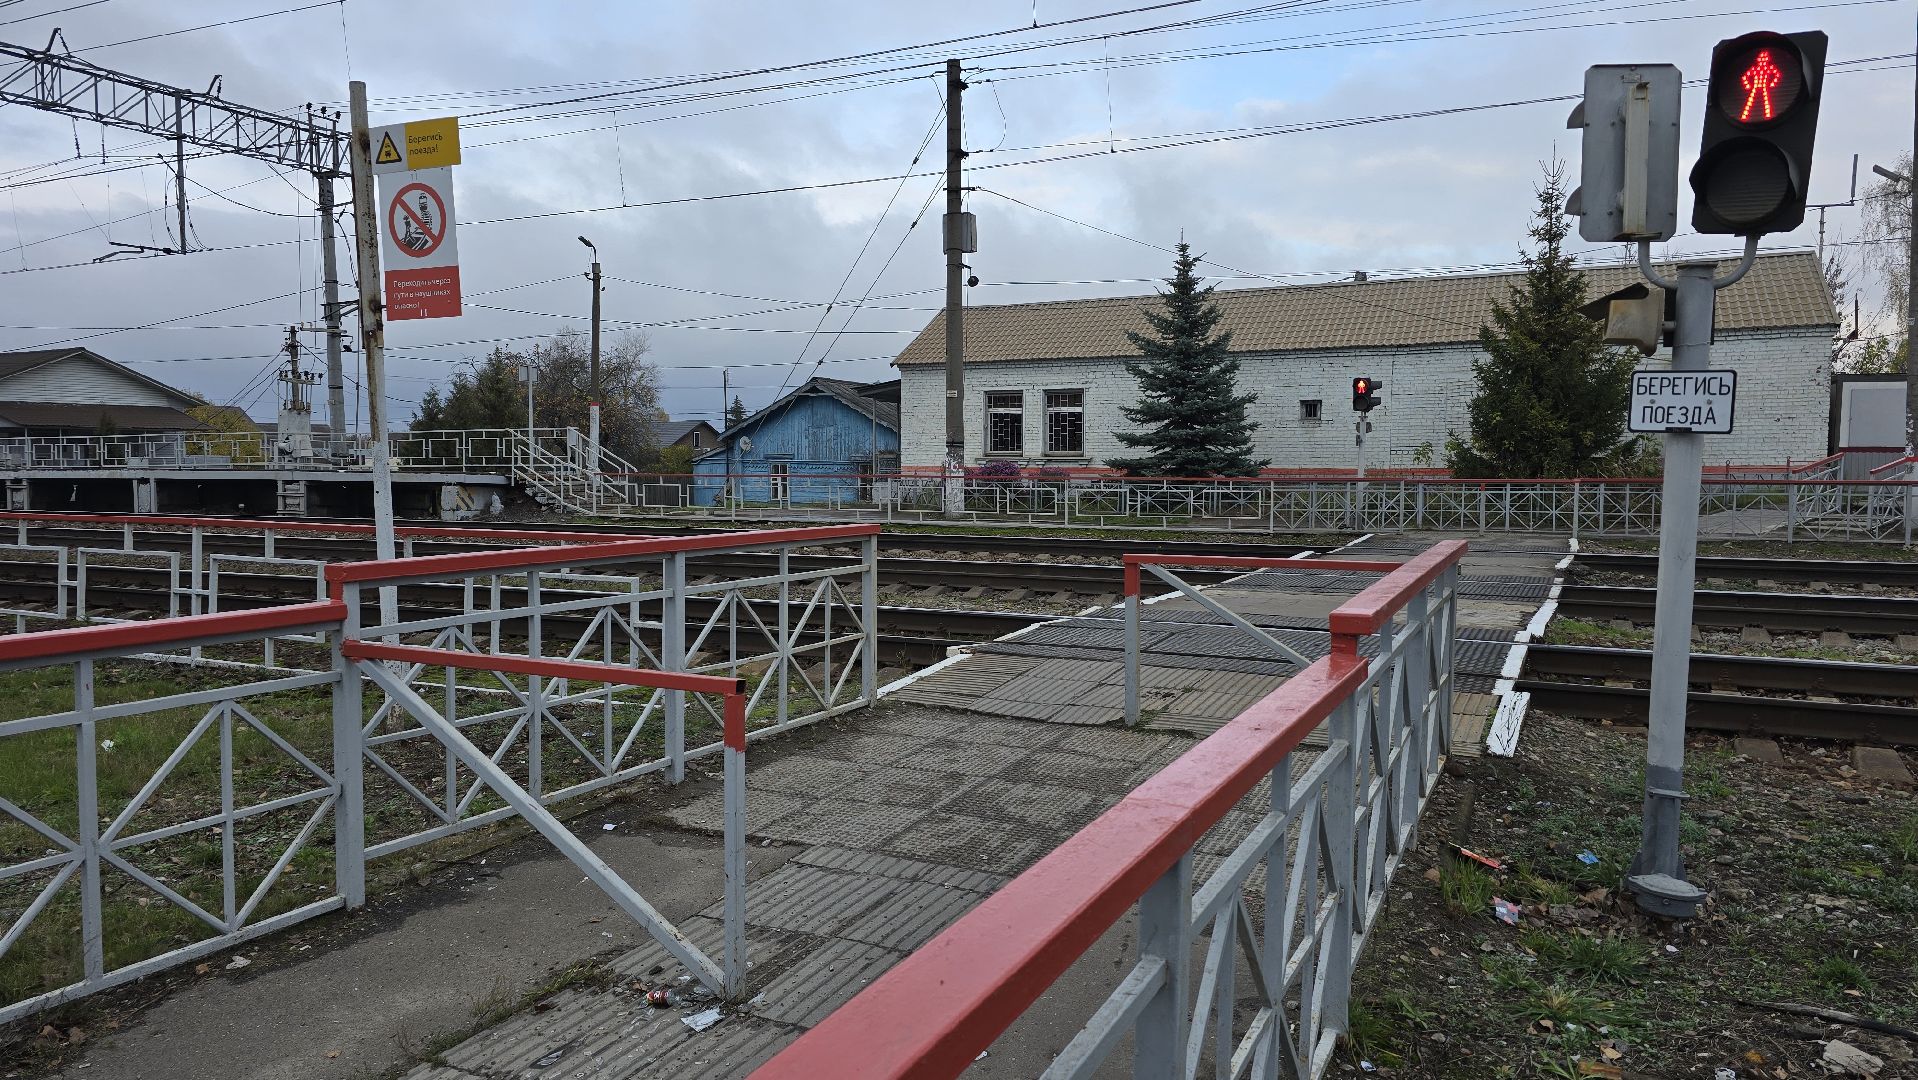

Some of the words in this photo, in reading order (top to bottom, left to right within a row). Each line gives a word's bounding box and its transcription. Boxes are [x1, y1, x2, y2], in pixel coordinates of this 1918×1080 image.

[408, 134, 443, 144] Берегись
[410, 144, 438, 155] поезда!
[1636, 376, 1731, 396] БЕРЕГИСЬ
[1641, 405, 1717, 425] ПОЕЗДА
